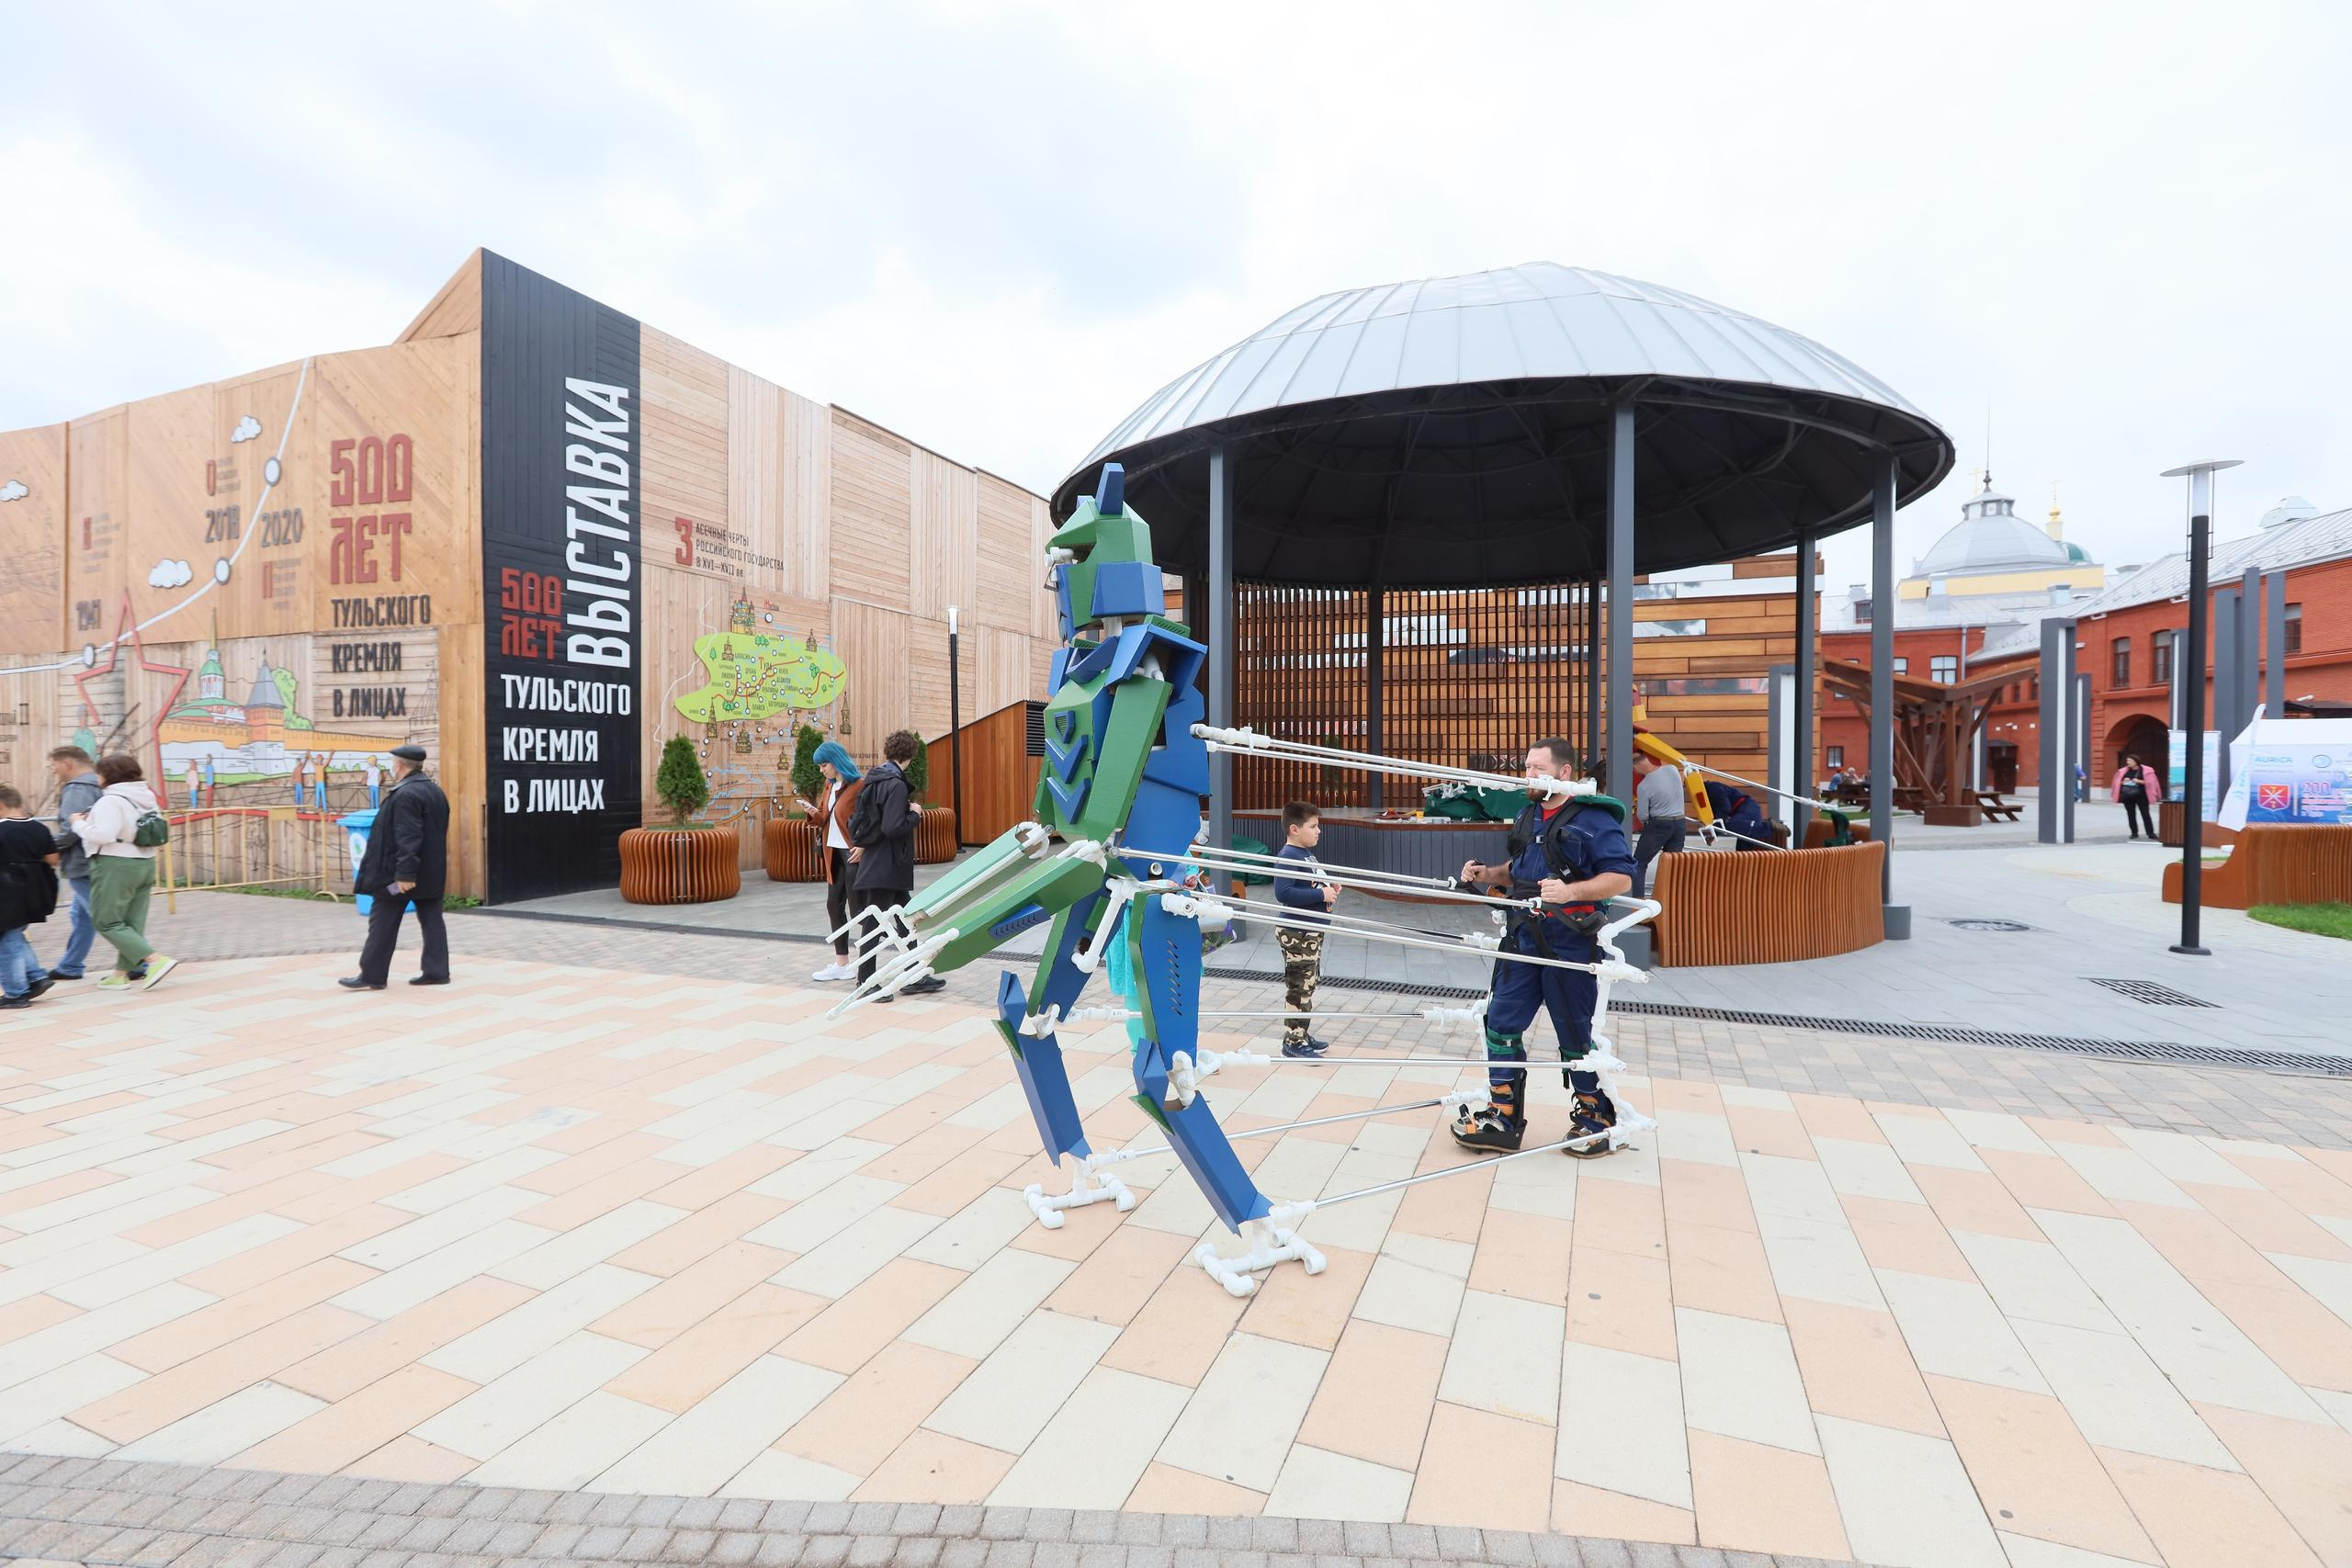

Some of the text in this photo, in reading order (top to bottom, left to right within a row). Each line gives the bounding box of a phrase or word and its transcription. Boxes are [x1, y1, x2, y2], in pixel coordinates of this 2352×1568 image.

[331, 433, 413, 507] 500
[261, 508, 303, 548] 2020
[565, 377, 630, 668] ВЫСТАВКА
[728, 533, 750, 547] ЧЕРТЫ
[330, 513, 413, 584] ЛЕТ
[695, 539, 785, 571] РОССИЙСКОГО ГОСУДАРСТВА
[501, 567, 561, 617] 500
[331, 594, 432, 628] ТУЛЬСКОГО
[501, 615, 561, 660] ЛЕТ
[332, 642, 402, 674] КРЕМЛЯ
[334, 686, 407, 719] В ЛИЦАХ
[501, 674, 631, 716] ТУЛЬСКОГО
[503, 727, 598, 762] КРЕМЛЯ
[504, 779, 605, 814] В ЛИЦАХ
